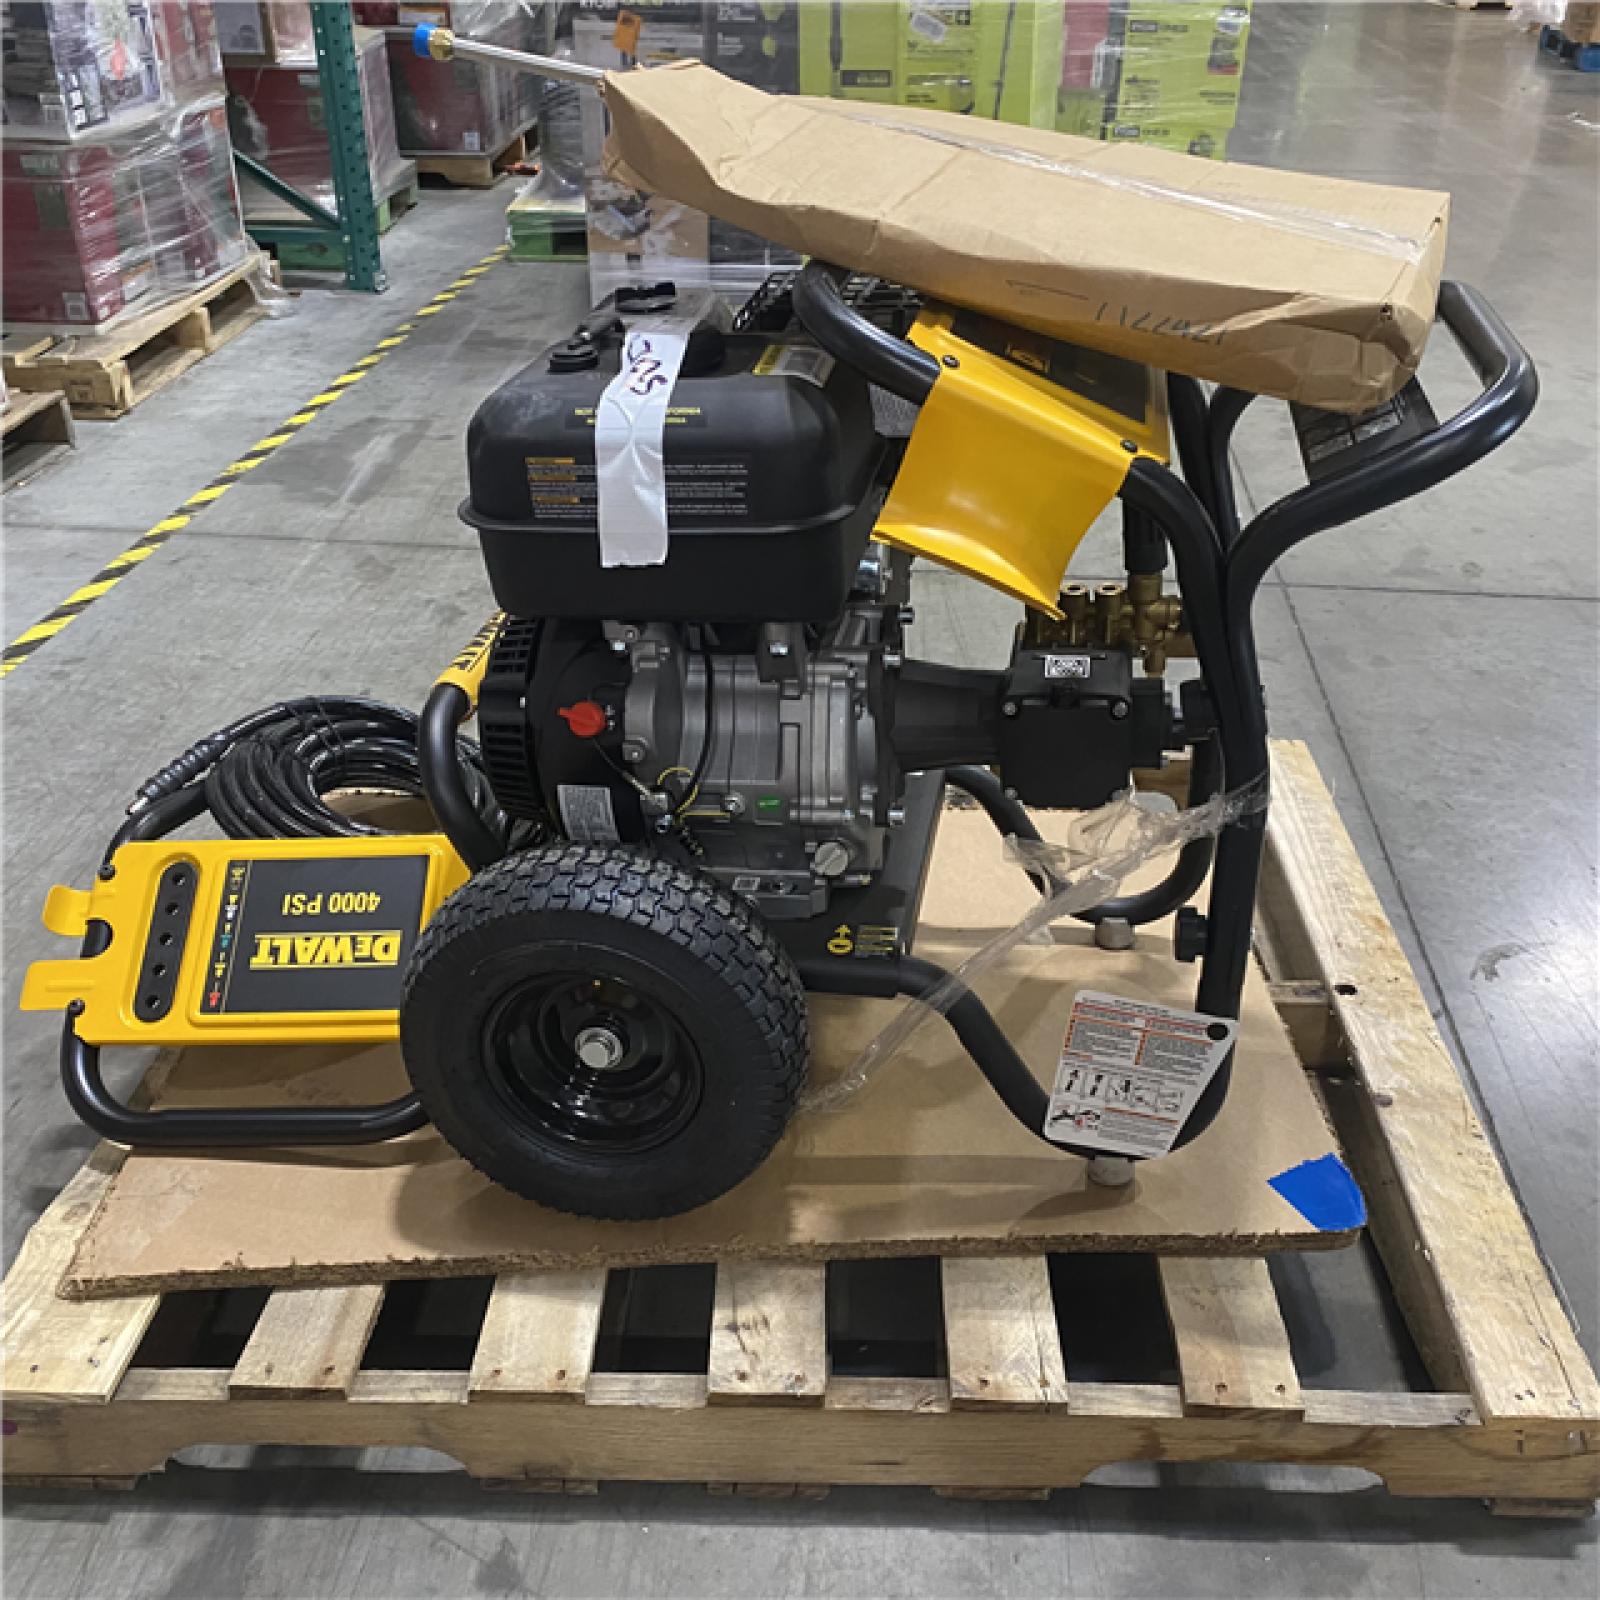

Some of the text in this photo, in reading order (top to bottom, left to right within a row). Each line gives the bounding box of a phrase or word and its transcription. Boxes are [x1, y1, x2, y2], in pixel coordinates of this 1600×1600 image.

[281, 890, 381, 916] 4000 PSI
[250, 931, 402, 969] DEWALT
